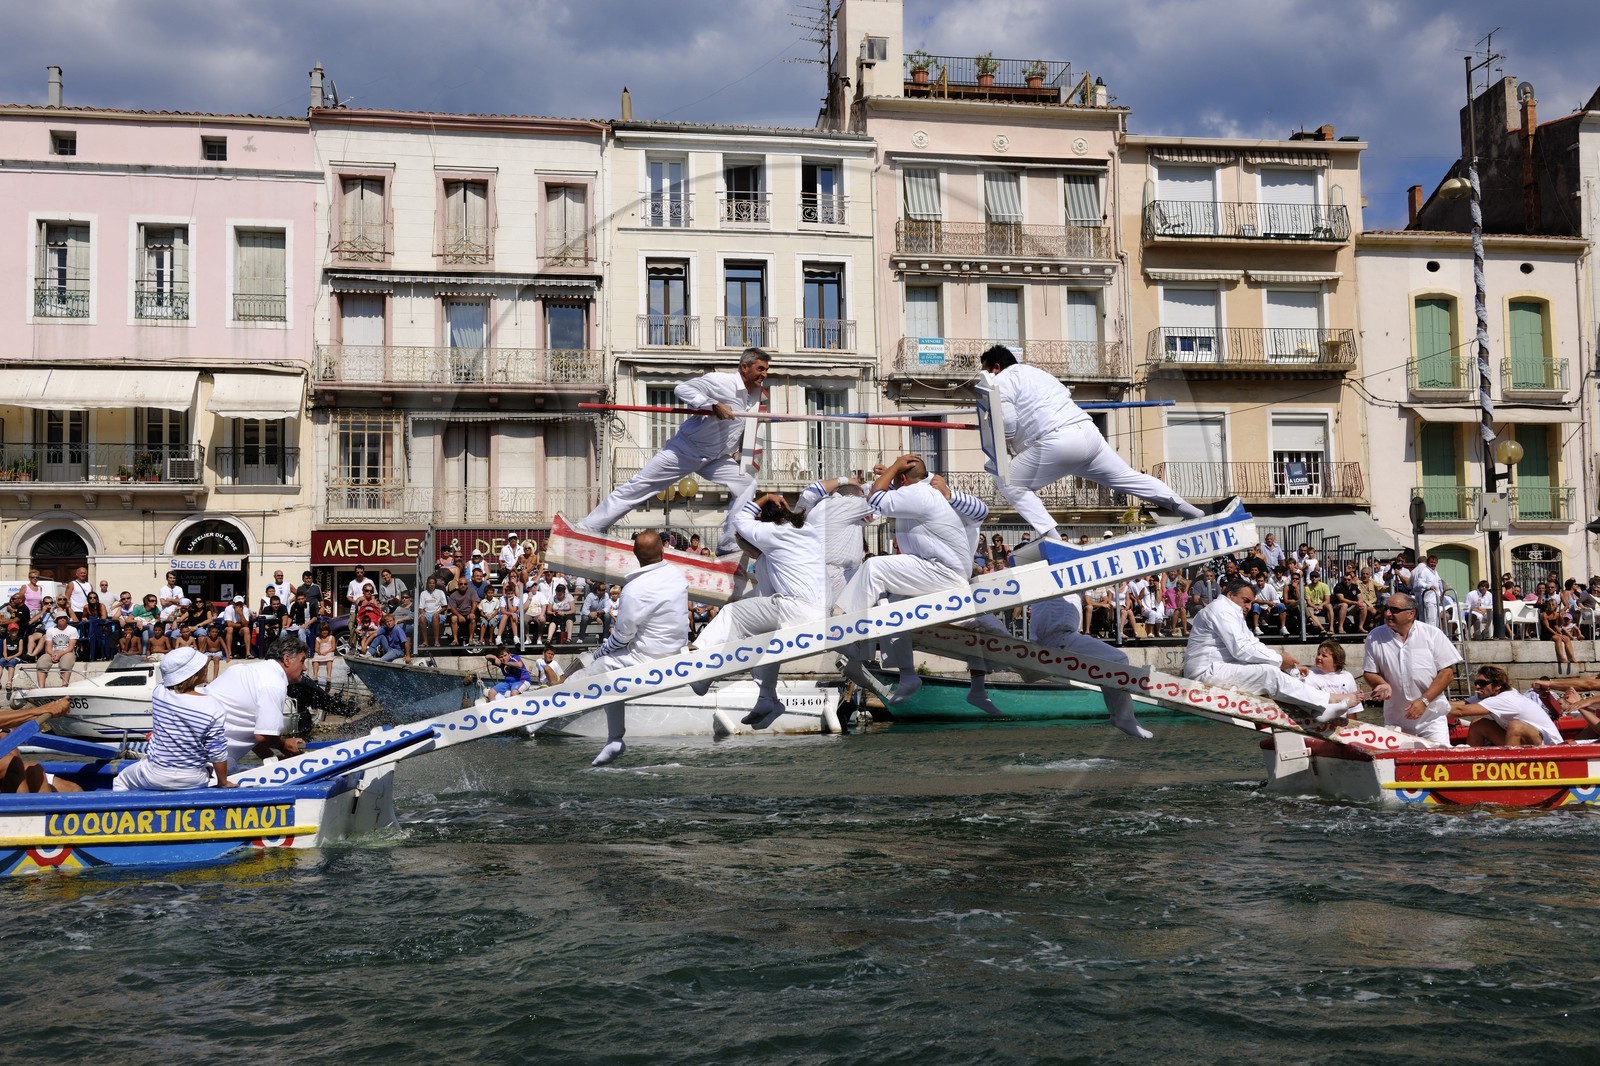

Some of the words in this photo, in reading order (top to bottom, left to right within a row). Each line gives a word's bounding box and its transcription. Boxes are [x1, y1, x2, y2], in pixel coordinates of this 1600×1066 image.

[187, 532, 214, 551] L'ATELIER
[223, 535, 238, 551] SIEGE
[323, 538, 424, 558] MEUBLE
[476, 538, 538, 557] DEO
[170, 559, 206, 569] SIEGES
[208, 559, 217, 569] &
[219, 559, 239, 569] ART
[1051, 555, 1124, 589] VILLE
[1133, 545, 1167, 570] DE
[1176, 526, 1239, 560] SETE
[1421, 765, 1449, 781] LA
[1472, 762, 1559, 780] PONCHA
[225, 804, 291, 829] NAUT
